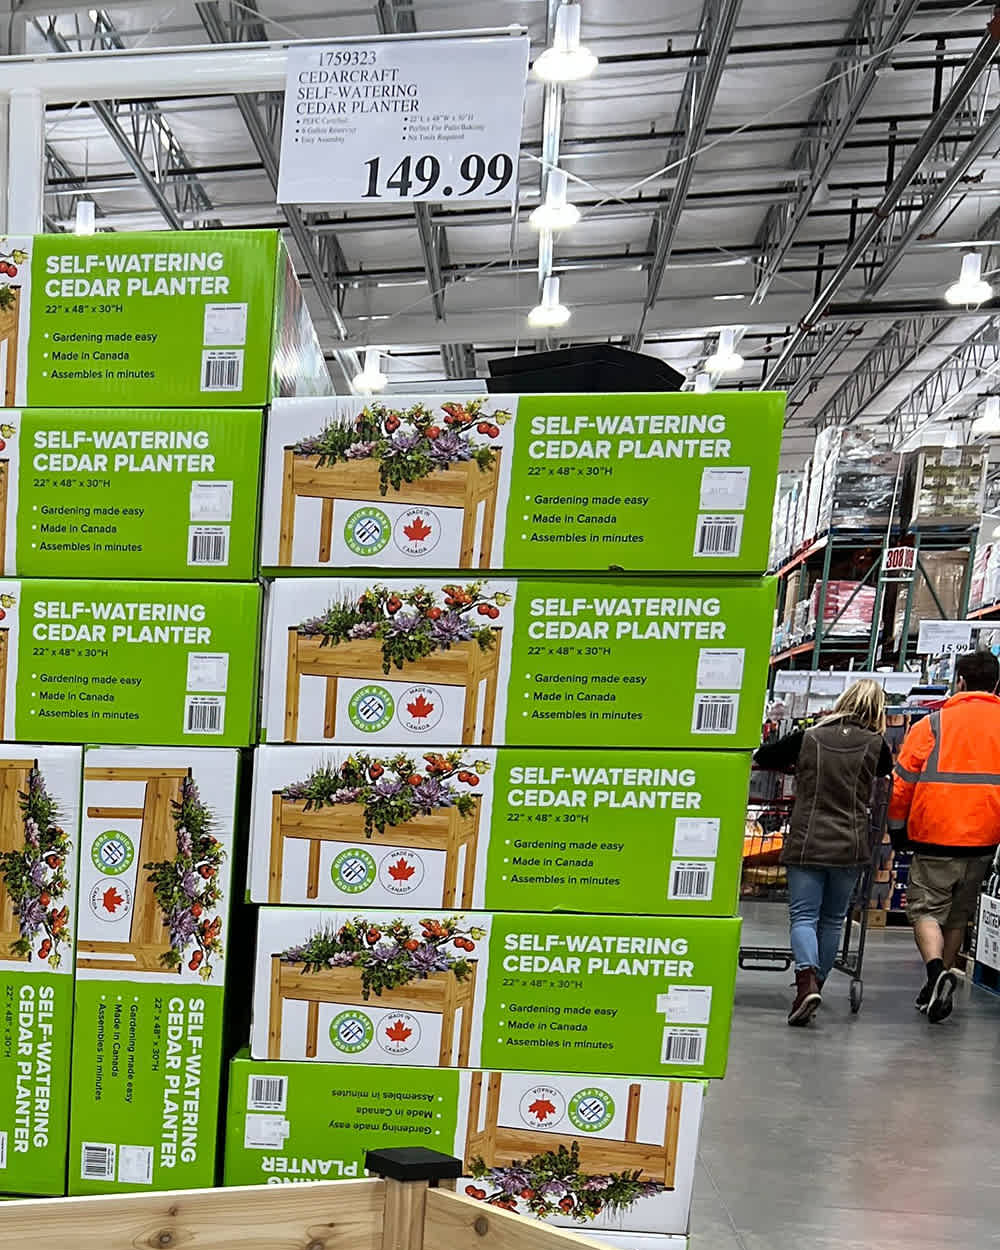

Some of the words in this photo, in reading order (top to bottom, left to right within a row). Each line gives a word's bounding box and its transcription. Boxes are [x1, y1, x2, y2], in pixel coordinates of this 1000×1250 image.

[319, 51, 376, 66] 1759323
[298, 68, 399, 84] CEDARCRAFT
[297, 84, 417, 100] SELF-WATERING
[296, 100, 346, 115] CEDAR
[352, 99, 419, 113] PLANTER
[361, 153, 513, 197] 149.99
[46, 252, 224, 274] SELF-WATERING
[45, 278, 121, 298] CEDAR
[127, 276, 230, 296] PLANTER
[52, 332, 103, 343] Gardening
[105, 333, 132, 341] made
[135, 334, 157, 343] easy
[52, 351, 78, 360] Made
[81, 352, 90, 360] in
[92, 351, 129, 360] Canada
[51, 370, 103, 379] Assembles
[105, 370, 114, 378] in
[117, 370, 155, 378] minutes
[530, 414, 726, 435] SELF-WATERING
[34, 430, 209, 449] SELF-WATERING
[528, 440, 612, 459] CEDAR
[618, 439, 731, 459] PLANTER
[33, 453, 108, 472] CEDAR
[114, 454, 216, 472] PLANTER
[534, 495, 589, 506] Gardening
[592, 496, 621, 504] made
[624, 497, 649, 506] easy
[532, 514, 561, 523] Made
[564, 515, 574, 523] in
[577, 514, 616, 523] Canada
[530, 533, 587, 542] Assembles
[590, 533, 599, 542] in
[602, 534, 644, 542] minutes
[33, 601, 206, 621] SELF-WATERING
[530, 597, 720, 616] SELF-WATERING
[32, 623, 106, 642] CEDAR
[112, 625, 212, 644] PLANTER
[528, 621, 610, 640] CEDAR
[615, 620, 726, 639] PLANTER
[941, 643, 968, 653] 15.99
[40, 673, 89, 685] Gardening
[91, 676, 117, 684] made
[120, 678, 141, 686] easy
[39, 691, 65, 700] Made
[68, 692, 76, 700] in
[79, 692, 114, 701] Canada
[38, 708, 89, 718] Assembles
[91, 710, 100, 718] in
[102, 711, 139, 719] minutes
[509, 767, 696, 786] SELF-WATERING
[507, 789, 587, 807] CEDAR
[593, 790, 701, 808] PLANTER
[514, 839, 566, 851] Gardening
[569, 841, 597, 850] made
[599, 843, 623, 852] easy
[512, 857, 540, 866] Made
[543, 858, 552, 866] in
[554, 858, 593, 867] Canada
[510, 874, 564, 884] Assembles
[567, 876, 576, 884] in
[579, 877, 619, 885] minutes
[504, 934, 688, 955] SELF-WATERING
[502, 955, 581, 974] CEDAR
[587, 957, 694, 976] PLANTER
[509, 1004, 561, 1016] Gardening
[563, 1007, 591, 1015] made
[594, 1008, 617, 1017] easy
[17, 985, 34, 1056] CEDAR
[508, 1021, 535, 1030] Made
[538, 1022, 547, 1030] in
[549, 1022, 587, 1031] Canada
[165, 997, 184, 1069] CEDAR
[506, 1037, 559, 1047] Assembles
[562, 1040, 571, 1048] in
[574, 1041, 613, 1049] minutes
[34, 986, 54, 1148] SELF-WATERING
[181, 998, 204, 1163] SELF-WATERING
[331, 1090, 369, 1098] minutes
[383, 1092, 434, 1102] Assembles
[14, 1061, 32, 1153] PLANTER
[356, 1107, 392, 1116] Canada
[406, 1109, 433, 1118] Made
[161, 1075, 180, 1168] PLANTER
[329, 1120, 351, 1128] easy
[382, 1122, 432, 1135] Gardening
[261, 1156, 358, 1176] PLANTER
